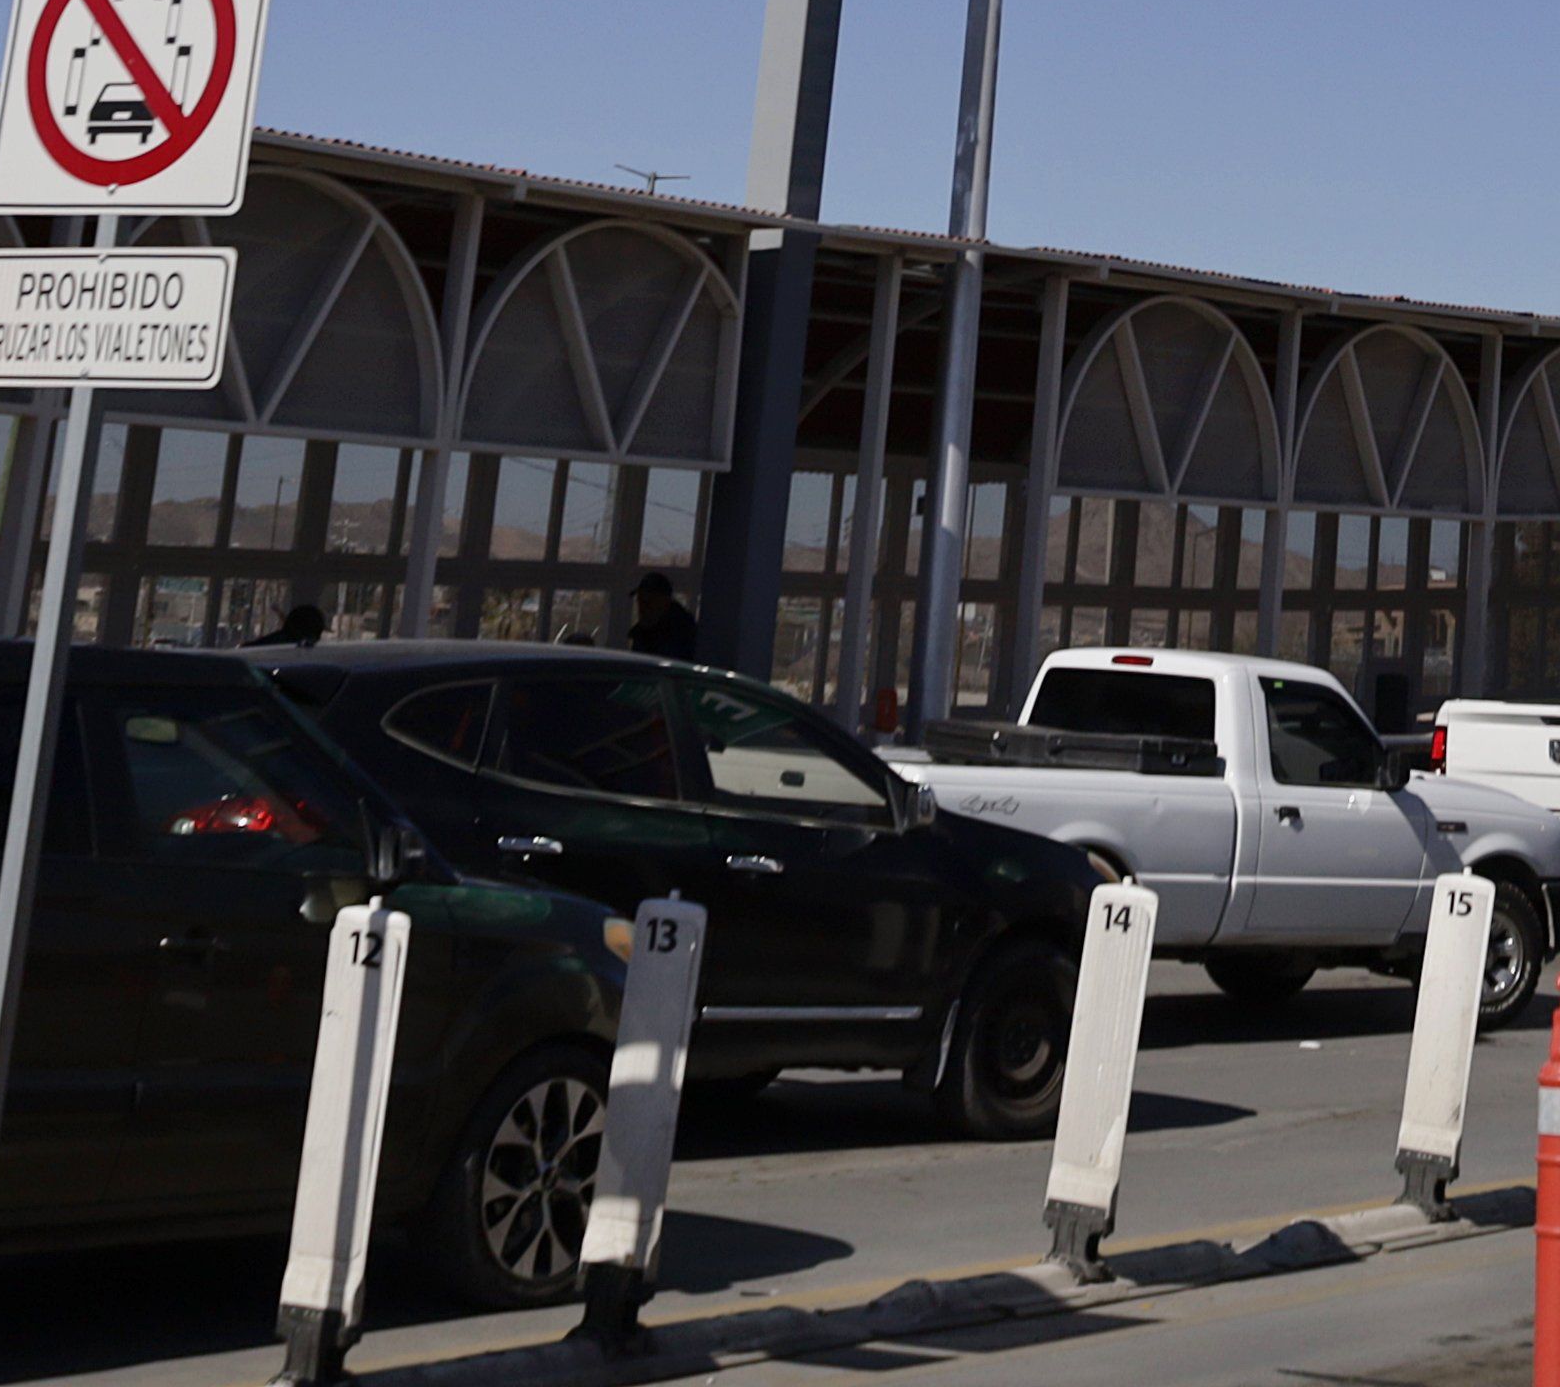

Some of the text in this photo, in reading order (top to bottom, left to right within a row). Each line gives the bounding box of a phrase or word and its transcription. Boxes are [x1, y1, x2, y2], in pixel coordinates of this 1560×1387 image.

[15, 271, 185, 311] PROHIBIDO
[54, 323, 89, 362] LOS
[93, 322, 210, 364] VIALETONES
[1102, 903, 1132, 934] 14
[1447, 889, 1474, 917] 15
[349, 929, 384, 968] 12
[647, 917, 678, 954] 13
